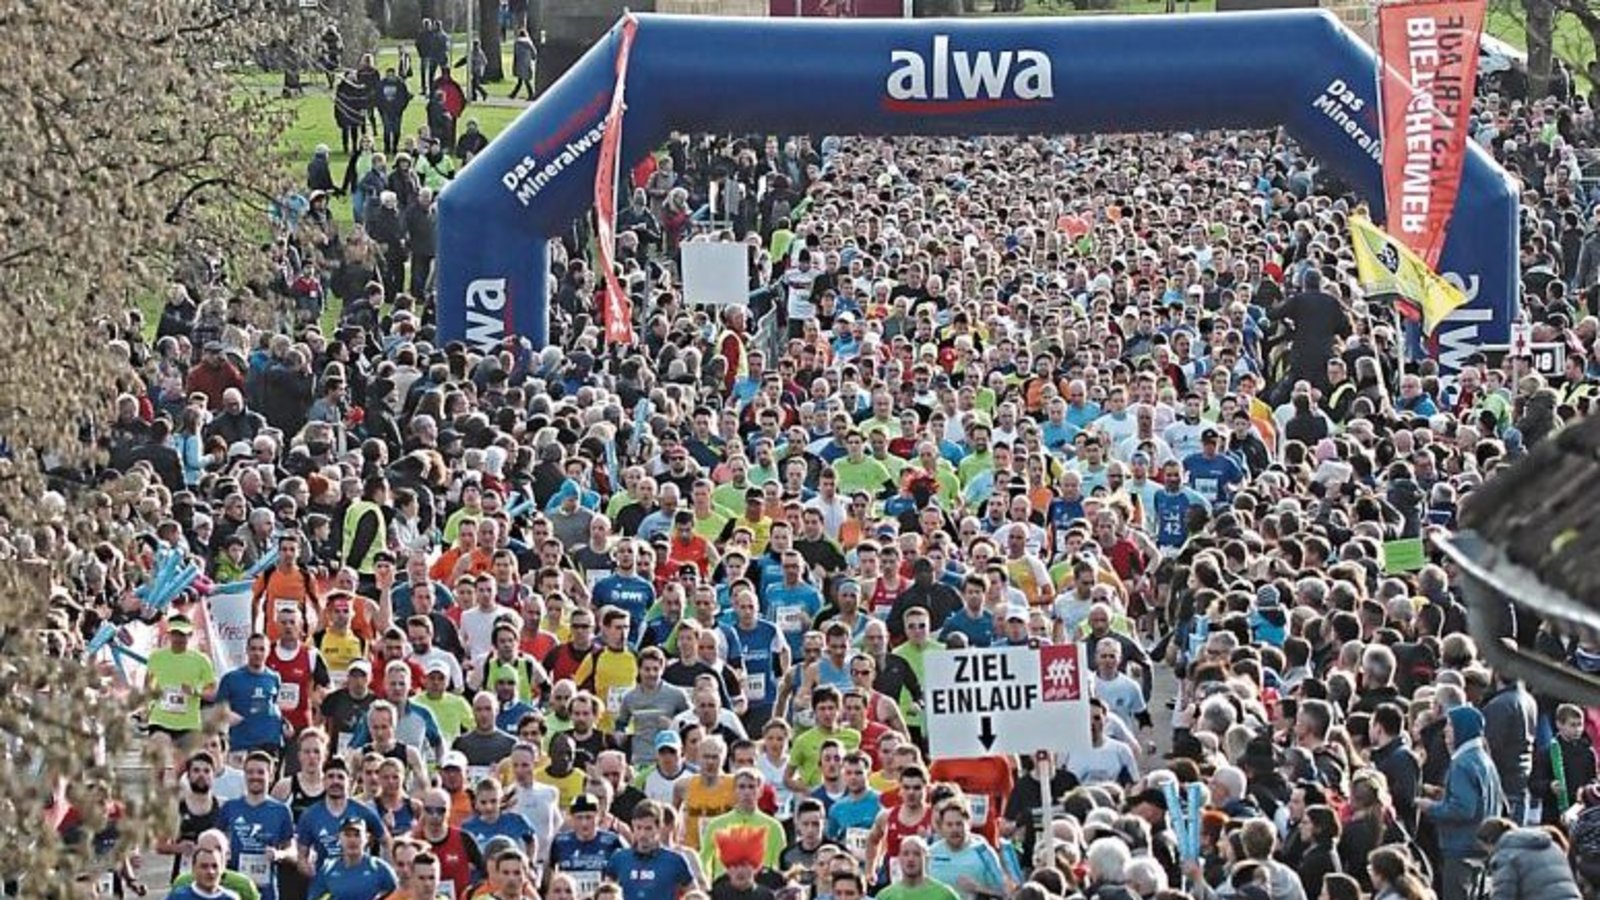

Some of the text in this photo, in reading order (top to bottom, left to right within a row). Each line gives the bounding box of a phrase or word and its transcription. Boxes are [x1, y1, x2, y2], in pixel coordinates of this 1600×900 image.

[887, 35, 1054, 100] alwa
[1326, 79, 1364, 112] Das
[503, 155, 536, 191] Das
[517, 114, 610, 206] Mineralwas
[1164, 523, 1182, 536] 42
[953, 653, 1016, 683] ZIEL
[932, 684, 1038, 715] EINLAUF
